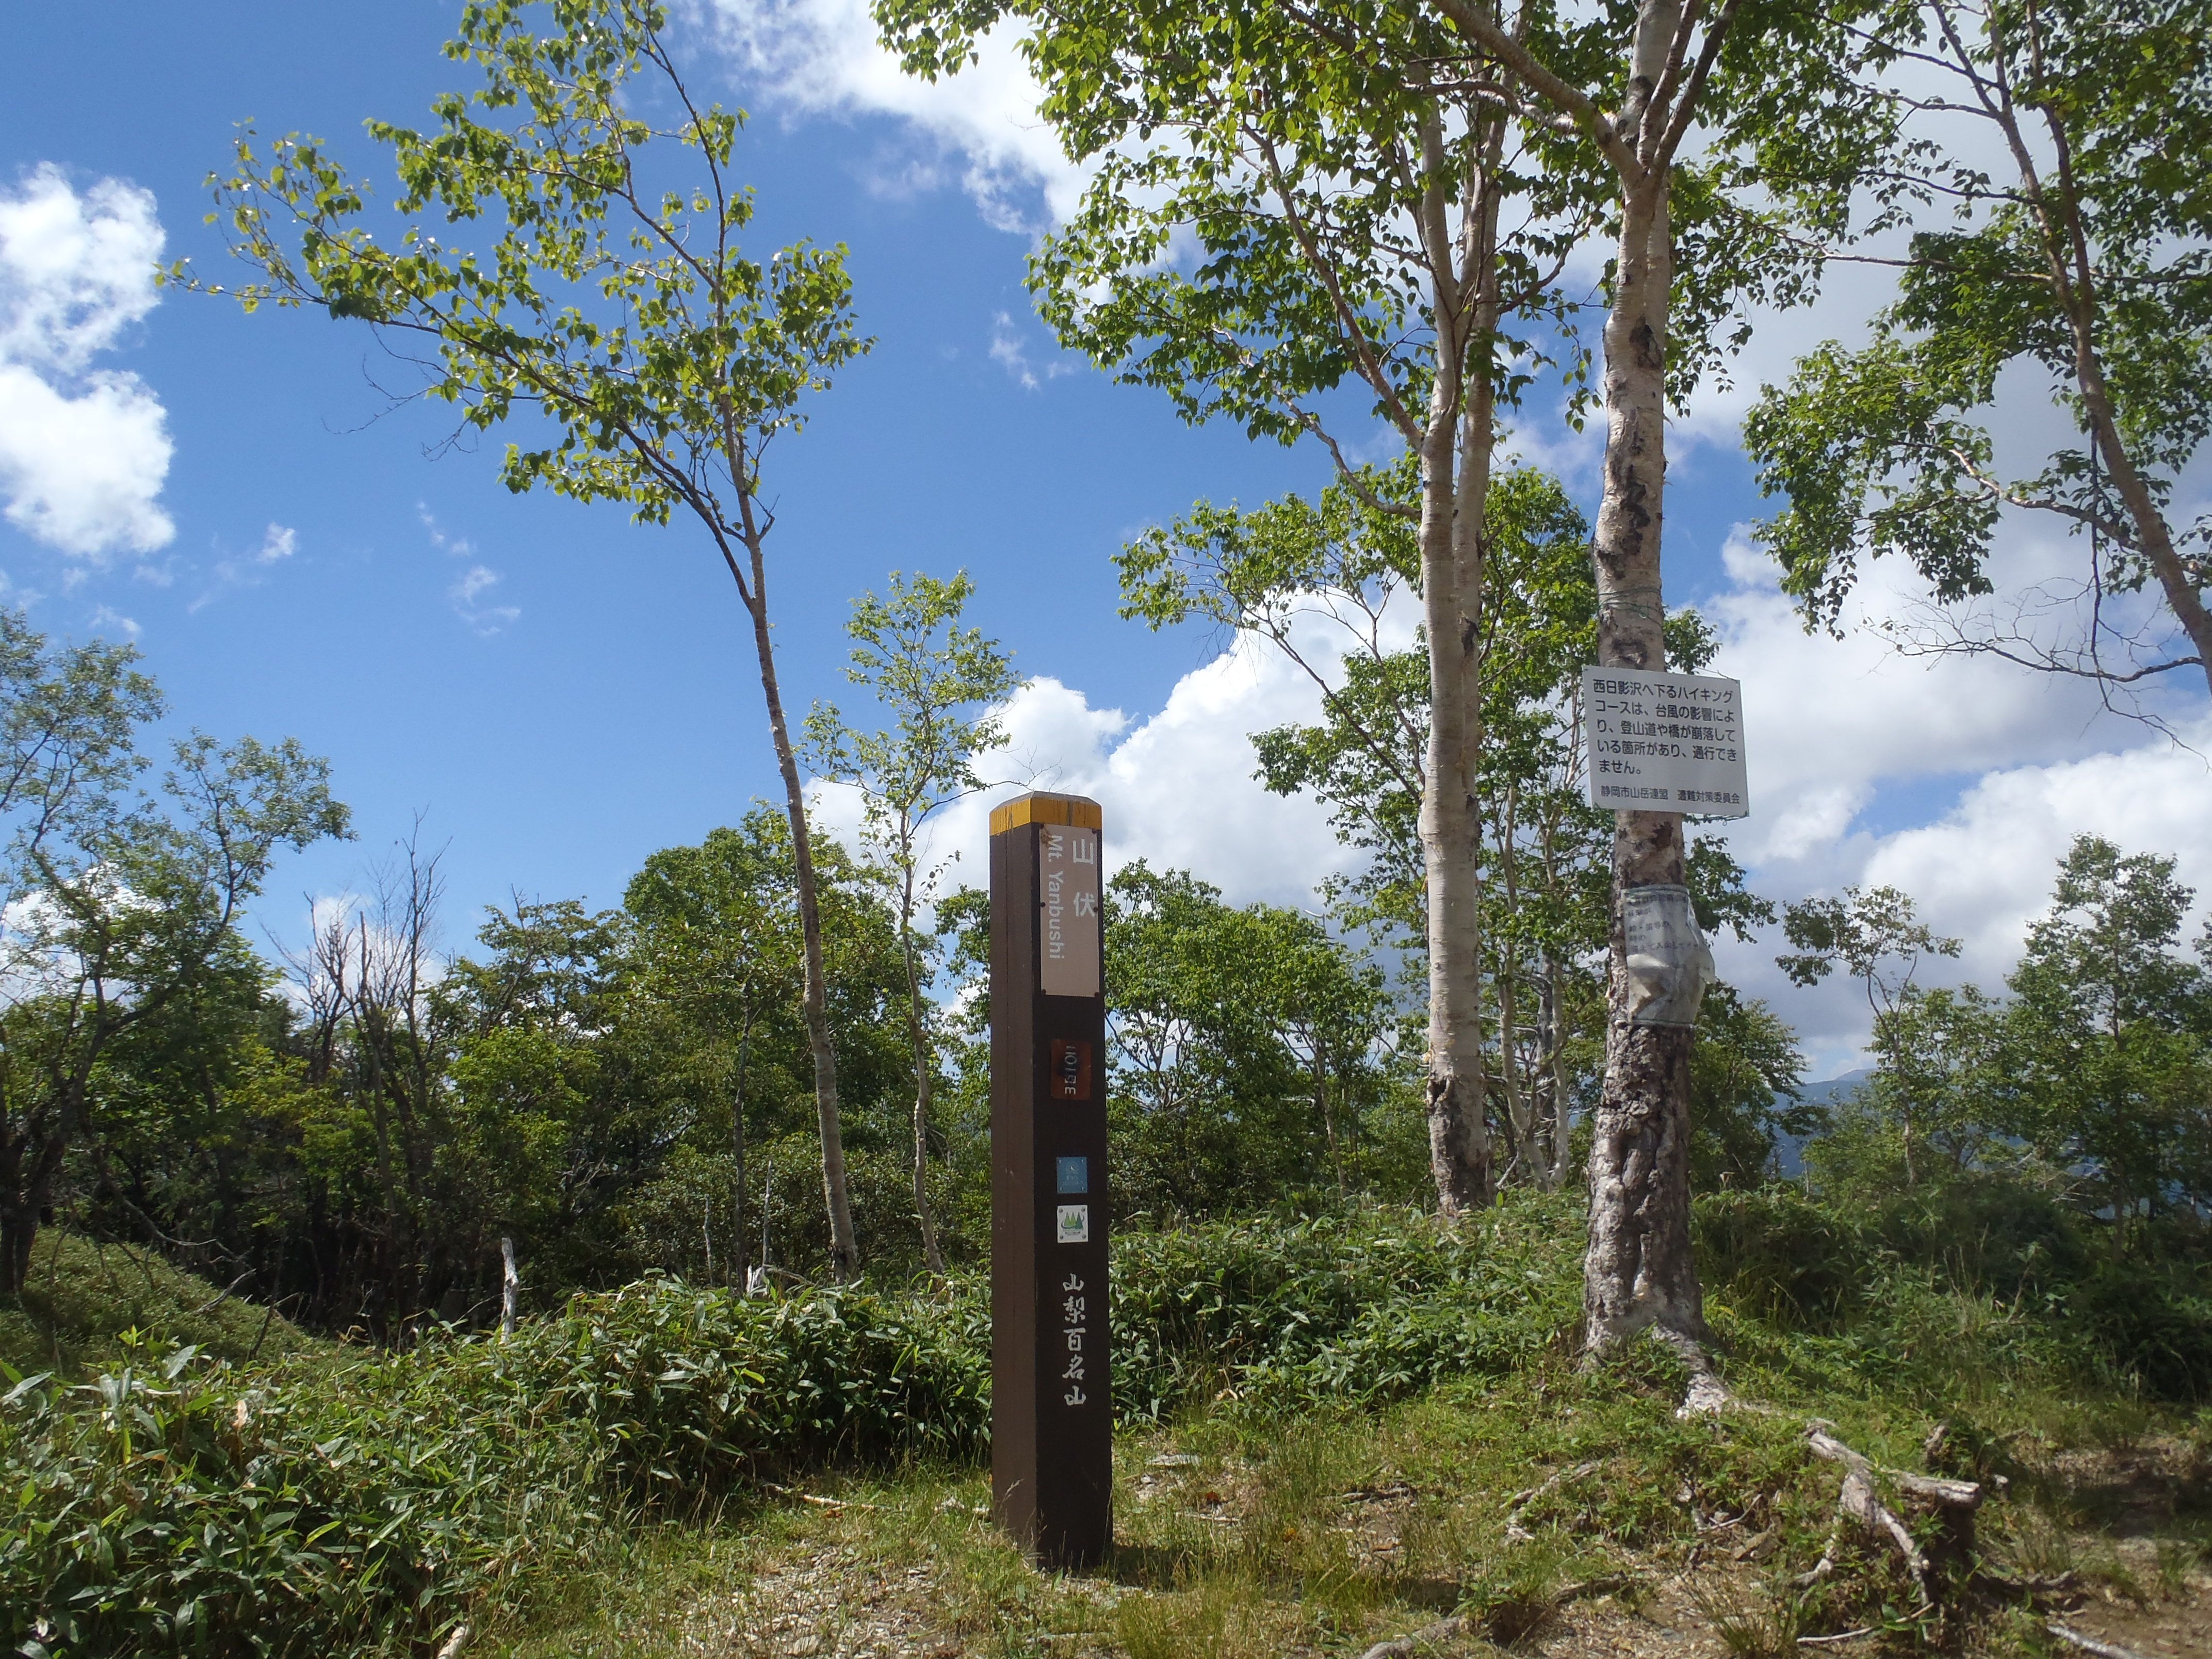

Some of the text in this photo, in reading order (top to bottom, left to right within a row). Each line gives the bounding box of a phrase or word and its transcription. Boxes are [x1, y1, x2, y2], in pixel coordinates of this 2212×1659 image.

[1593, 679, 1733, 703] 西日影沢へ下るハイキング
[1596, 700, 1734, 723] コースは、台風の影響によ
[1597, 719, 1736, 742] り、登山道や橋が崩落して
[1597, 740, 1737, 762] いる箇所があり、通行でき
[1599, 760, 1641, 775] ません。
[1601, 786, 1668, 801] 静岡市山岳連盟
[1072, 838, 1095, 917] 山伏
[1047, 835, 1065, 959] Mt. Yanbushi
[1062, 1273, 1086, 1406] 山梨百名山
